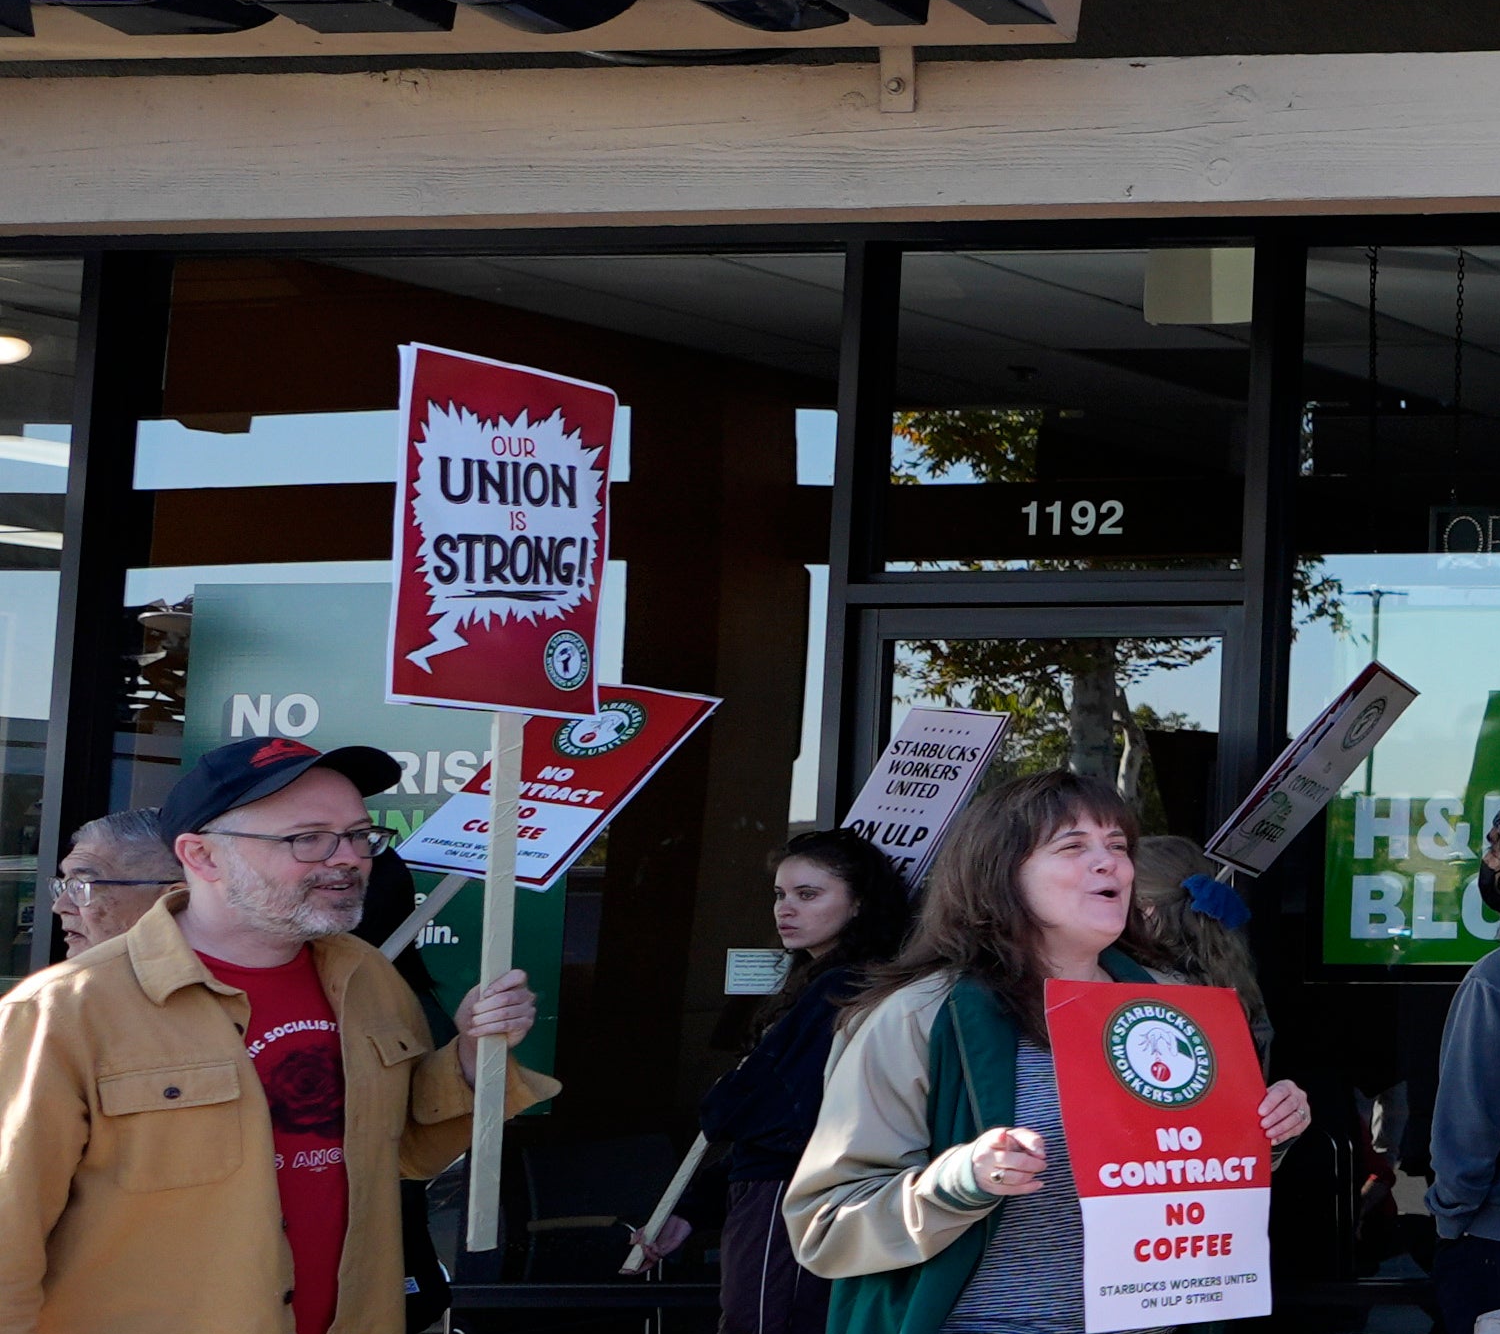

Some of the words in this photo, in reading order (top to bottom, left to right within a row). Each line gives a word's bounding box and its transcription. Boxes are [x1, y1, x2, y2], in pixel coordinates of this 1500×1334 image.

[491, 435, 536, 458] OUR
[438, 456, 577, 509] UNION
[509, 510, 526, 532] IS
[1021, 500, 1125, 537] 1192
[432, 533, 590, 589] STRONG!
[231, 693, 320, 738] NO
[890, 739, 981, 763] STARBUCKS
[537, 766, 575, 782] NO
[888, 760, 962, 781] WORKERS
[885, 780, 939, 799] UNITED
[881, 822, 929, 848] ULP
[264, 1020, 341, 1043] SOCIALIST
[1113, 1005, 1196, 1043] STARBUCKS
[1112, 1045, 1175, 1103] WORKERS
[1183, 1045, 1210, 1101] UNITED
[1156, 1126, 1203, 1152] NO
[1099, 1157, 1257, 1189] CONTRACT
[1165, 1202, 1206, 1227] NO
[1134, 1233, 1233, 1263] COFFEE
[1100, 1280, 1167, 1297] STARBUCKS
[1170, 1276, 1222, 1291] WORKERS
[1224, 1273, 1258, 1285] UNITED
[1141, 1297, 1157, 1309] ON
[1161, 1296, 1182, 1307] ULP
